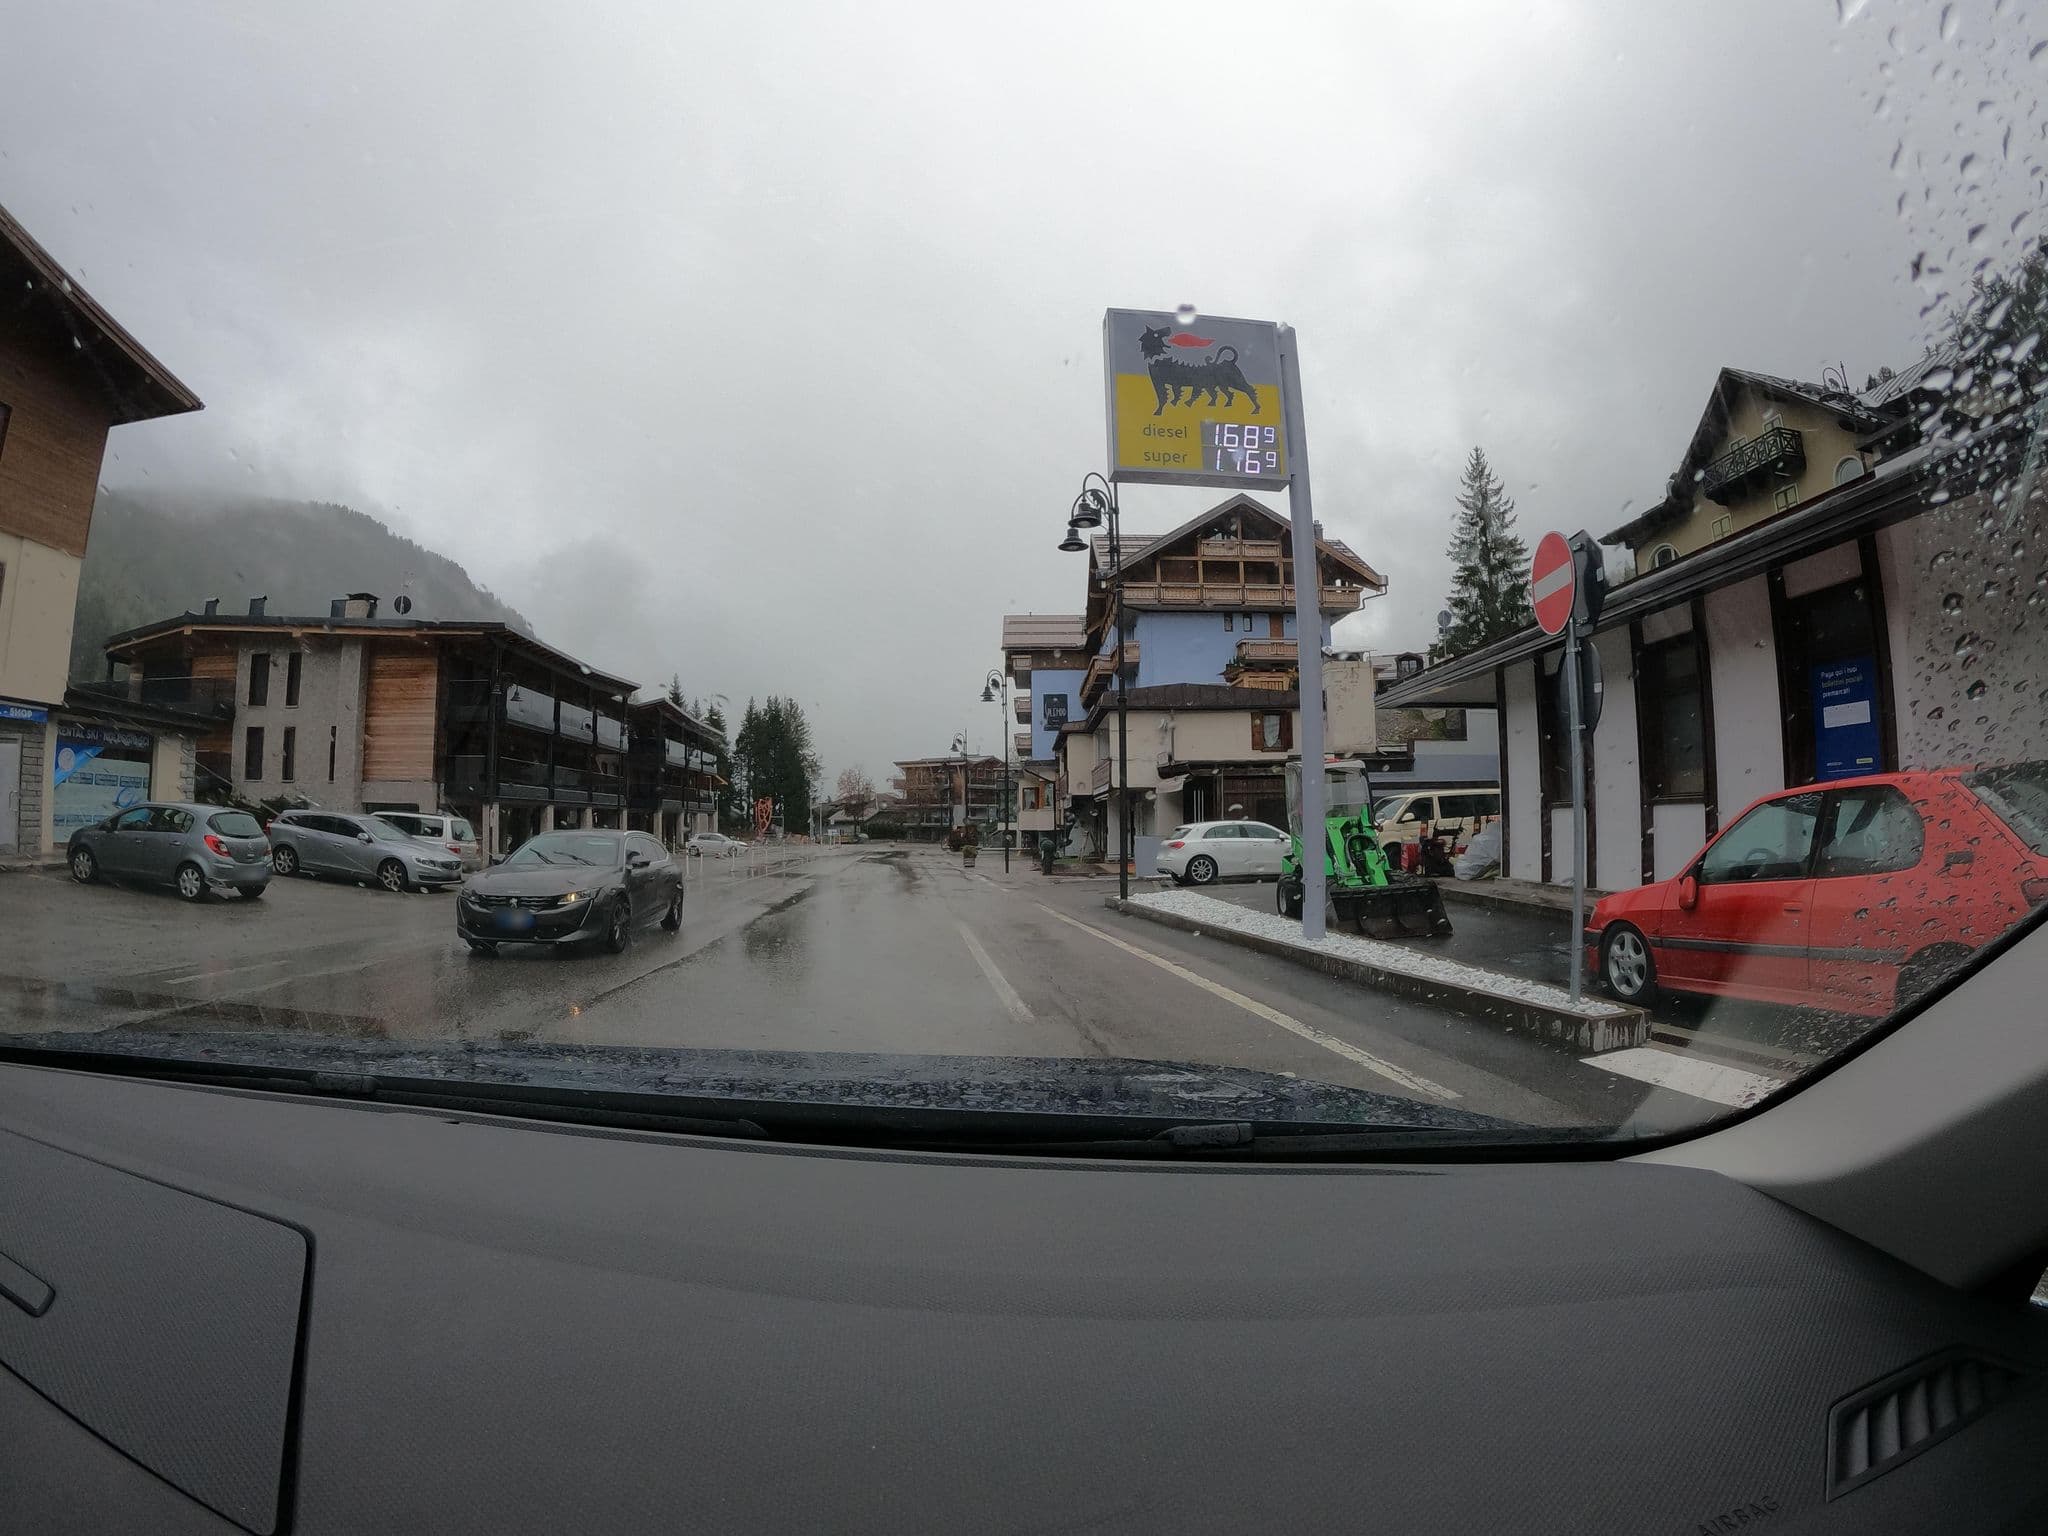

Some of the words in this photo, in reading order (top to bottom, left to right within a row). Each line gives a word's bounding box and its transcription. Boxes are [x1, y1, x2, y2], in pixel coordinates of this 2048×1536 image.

[1142, 423, 1188, 439] diesel
[1143, 451, 1188, 465] super
[9, 707, 33, 718] SHOP
[1697, 1495, 1780, 1536] AIRBAG
